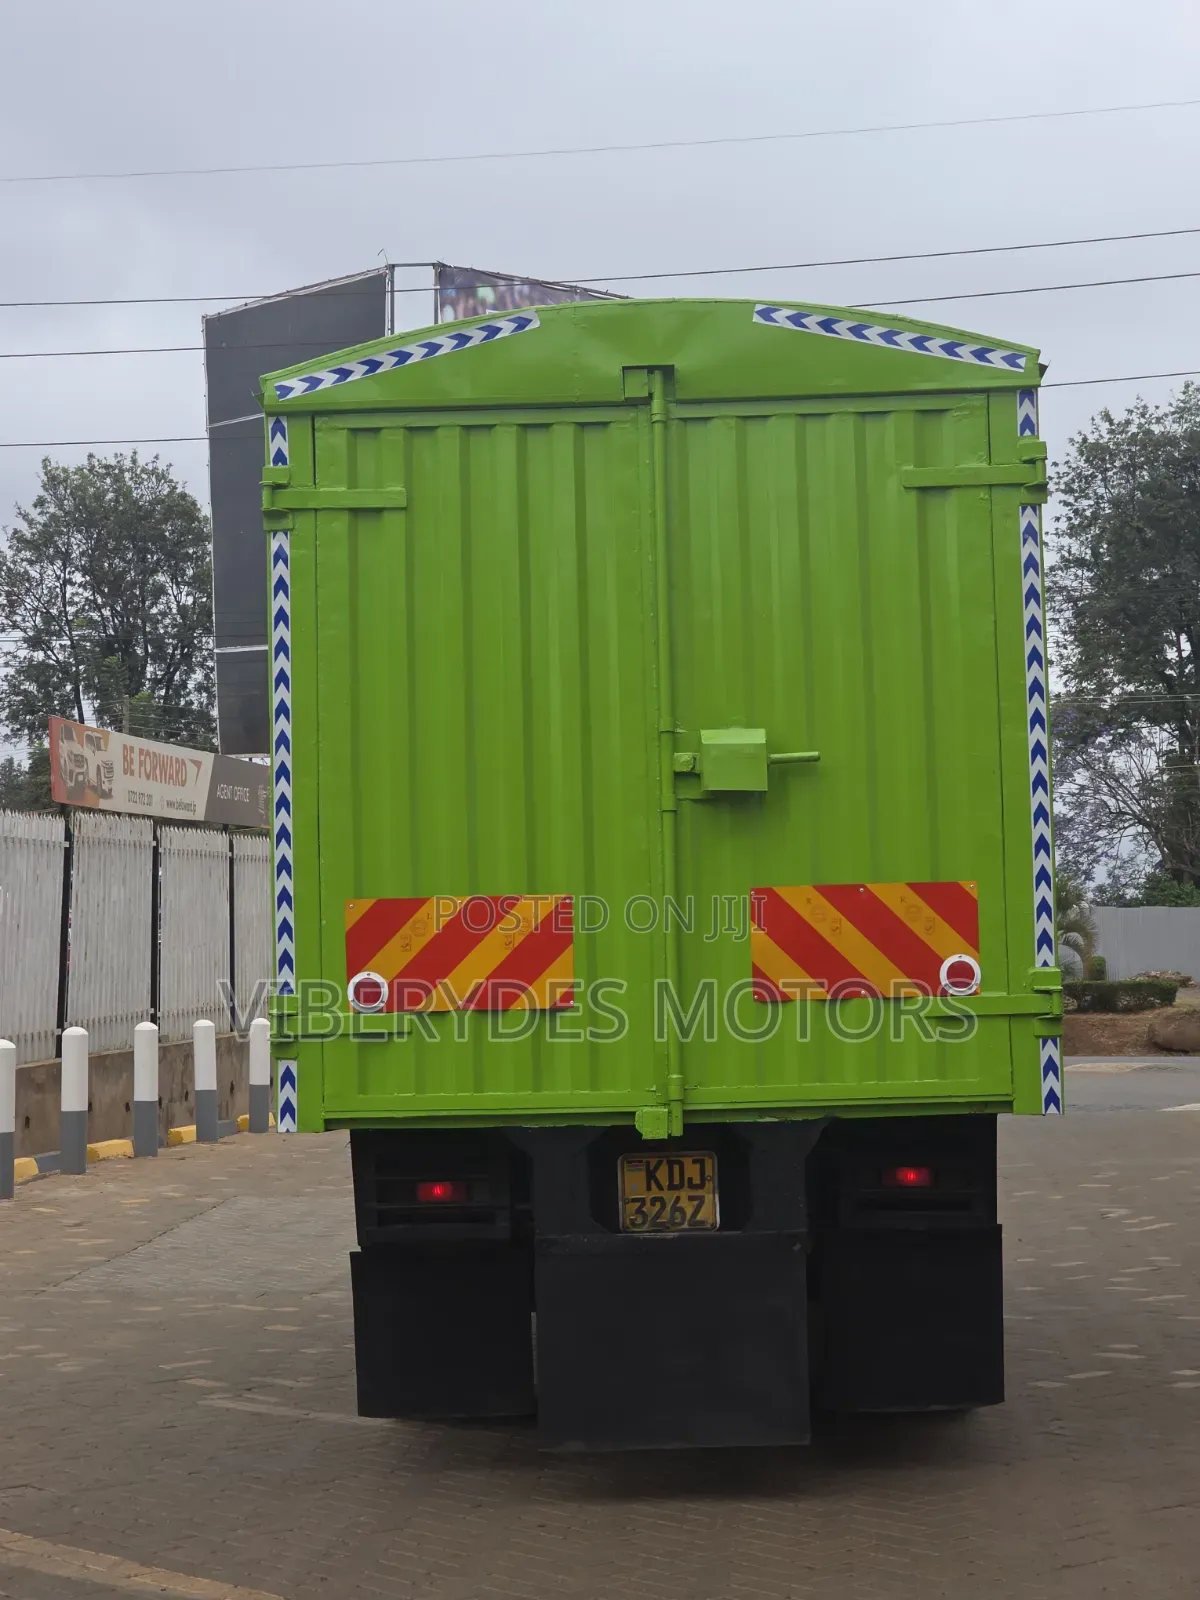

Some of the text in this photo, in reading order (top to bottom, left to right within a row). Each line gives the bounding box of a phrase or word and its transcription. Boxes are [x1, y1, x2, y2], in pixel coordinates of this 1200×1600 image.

[122, 743, 188, 788] BE FORWARD
[216, 783, 250, 802] AGENT OFFICE
[645, 1158, 707, 1192] KDJ
[627, 1195, 707, 1230] 326Z
